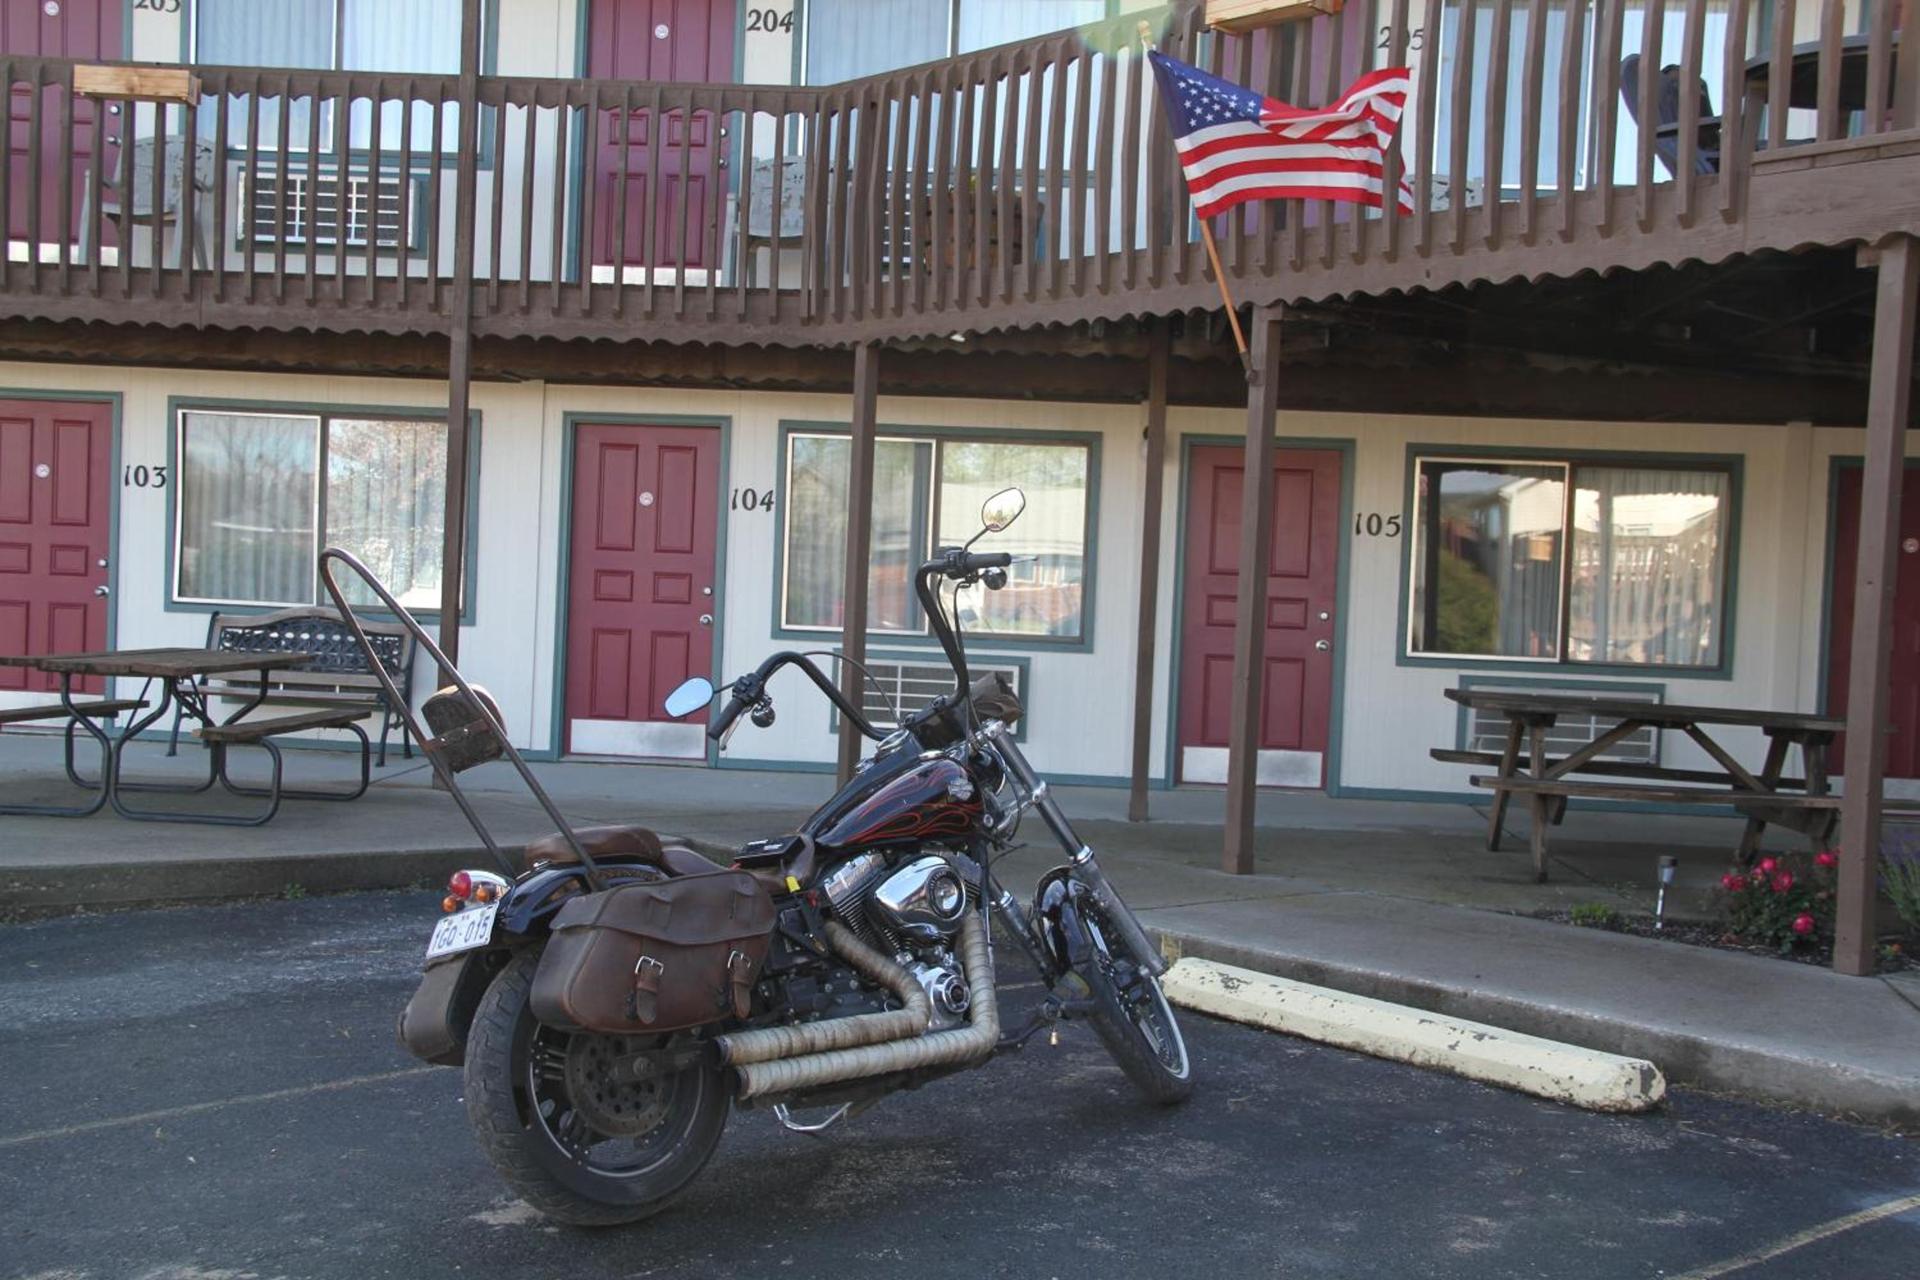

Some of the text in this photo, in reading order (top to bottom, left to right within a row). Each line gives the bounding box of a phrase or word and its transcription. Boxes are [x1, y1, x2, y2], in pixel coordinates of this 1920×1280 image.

[746, 9, 794, 34] 204
[1377, 26, 1424, 50] 25
[124, 465, 167, 488] 103
[731, 488, 775, 512] 104
[1355, 512, 1401, 537] 105
